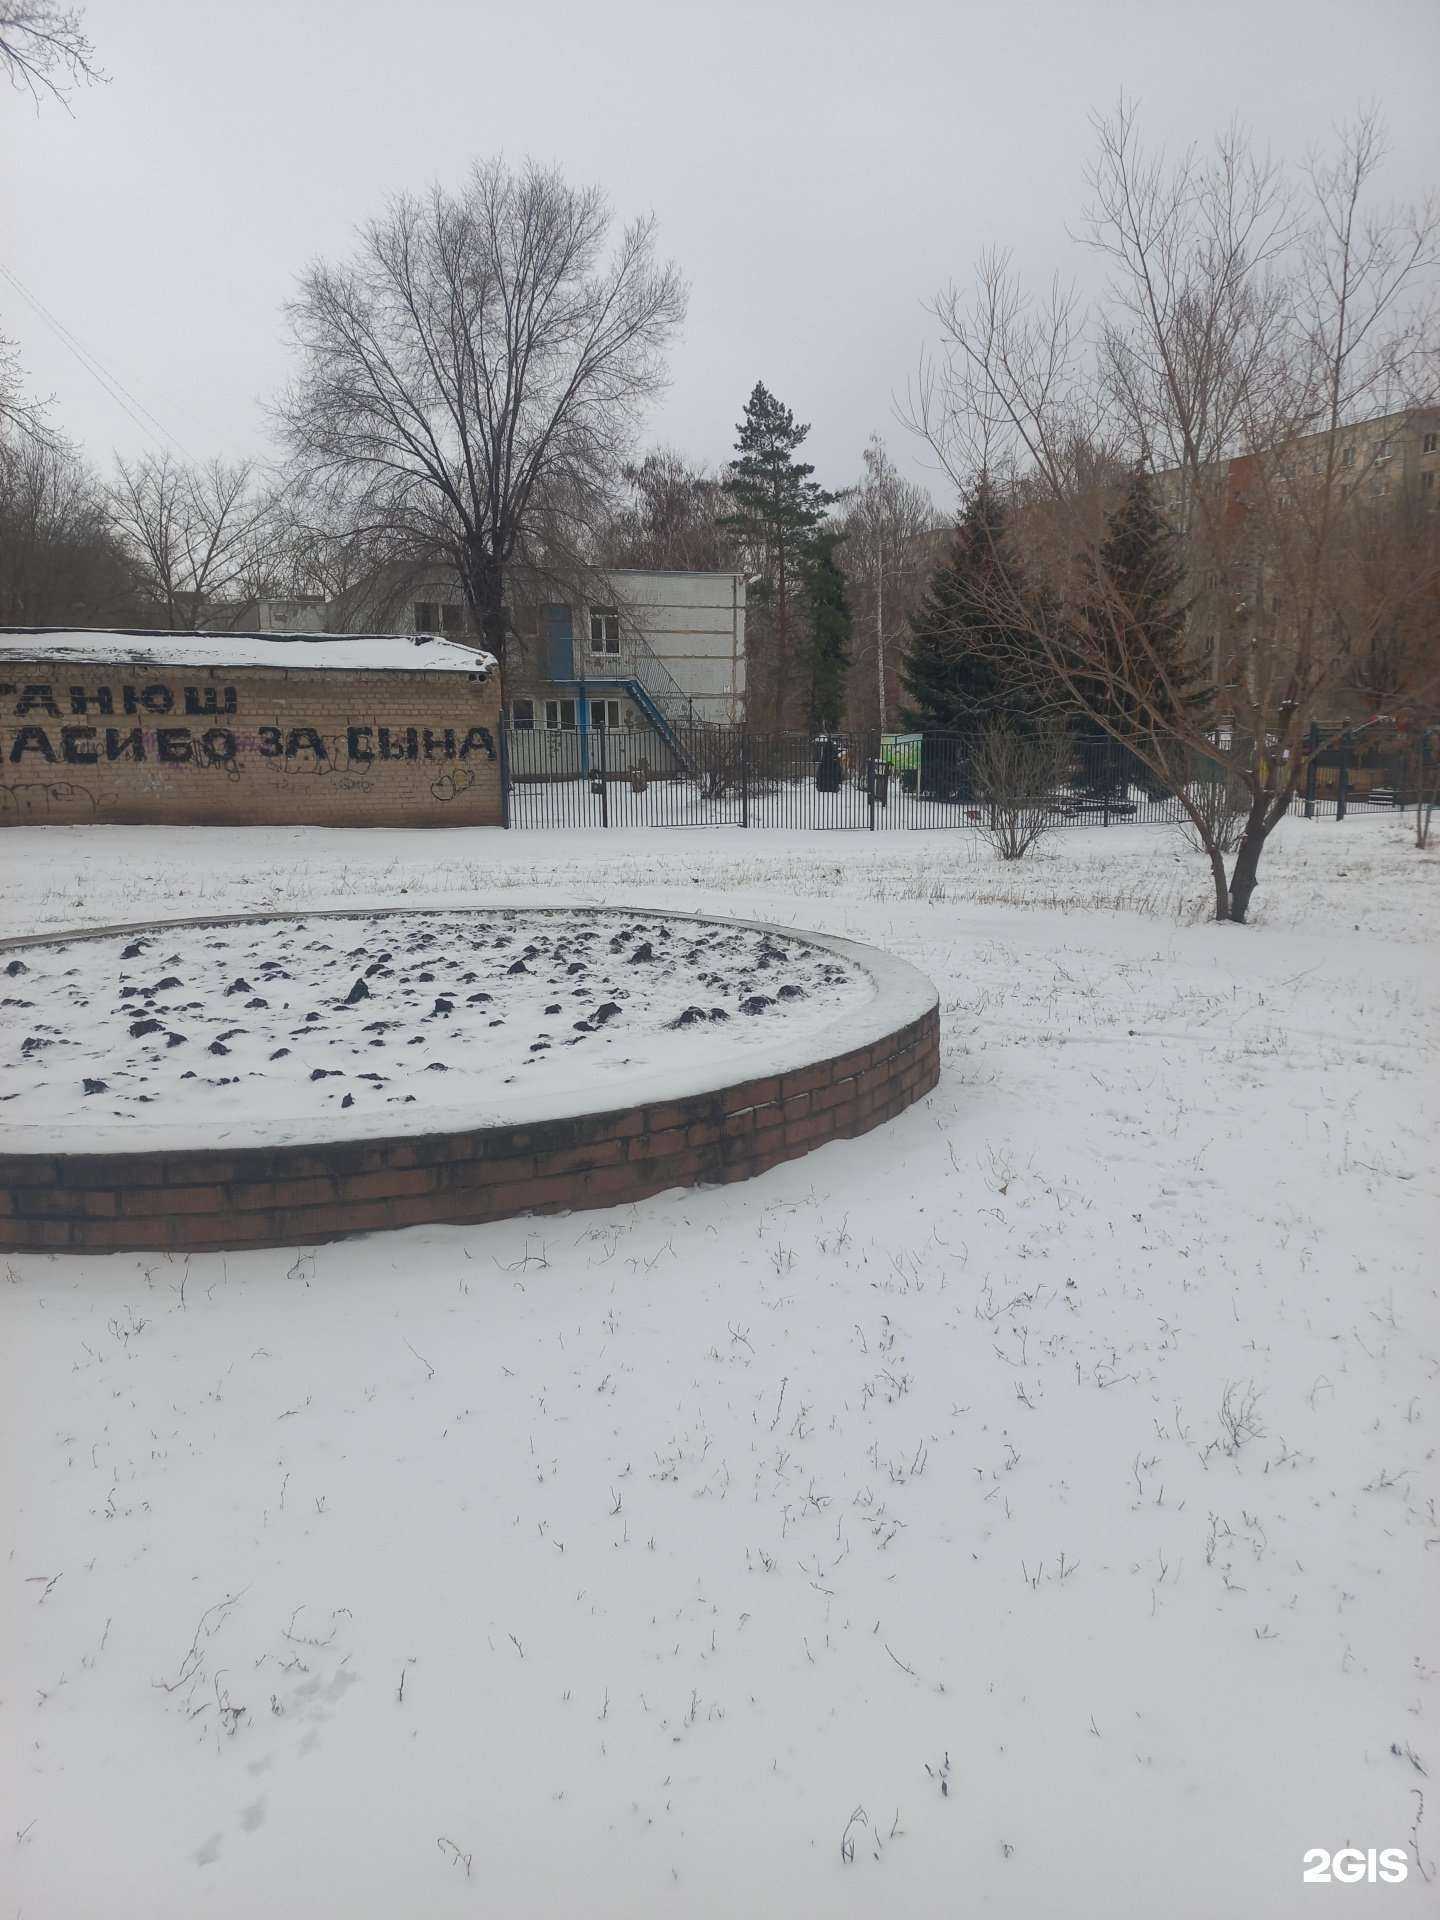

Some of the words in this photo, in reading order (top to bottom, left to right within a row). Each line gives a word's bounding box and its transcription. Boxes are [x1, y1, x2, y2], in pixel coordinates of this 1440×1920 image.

[0, 725, 237, 763] АСИБО
[258, 726, 328, 762] ЗА
[347, 727, 497, 761] СЫНА
